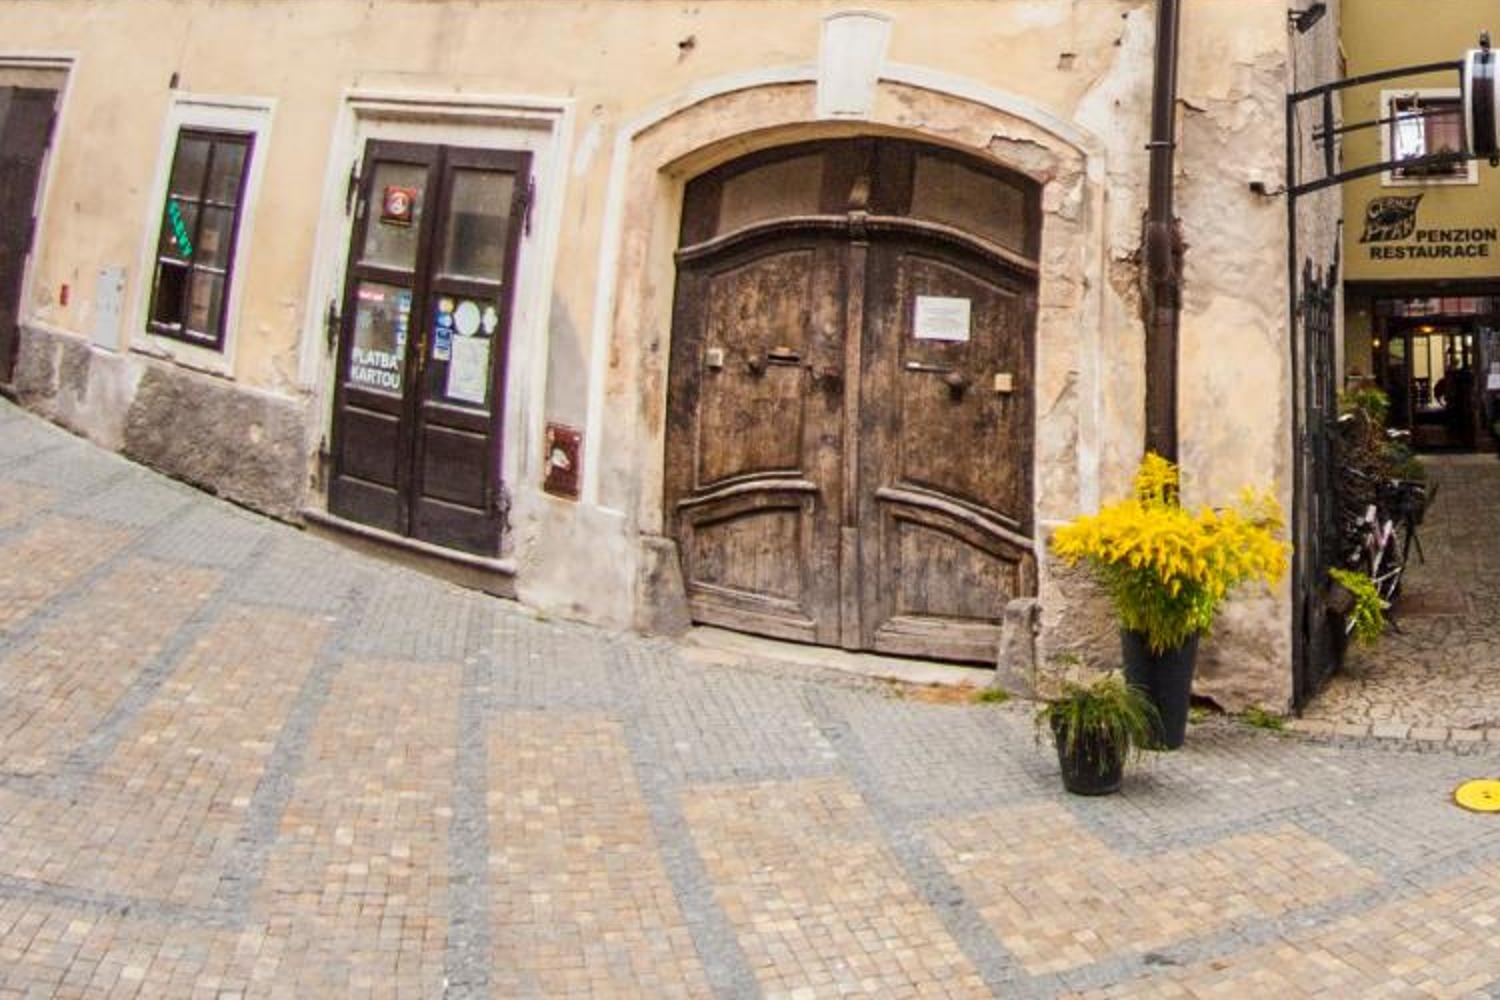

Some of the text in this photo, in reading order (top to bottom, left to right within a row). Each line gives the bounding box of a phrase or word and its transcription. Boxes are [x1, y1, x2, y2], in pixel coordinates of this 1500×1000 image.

[1415, 227, 1497, 243] PENZION
[1369, 243, 1489, 260] RESTAURACE
[352, 347, 400, 370] PLATBA
[350, 364, 400, 389] KARTOU
